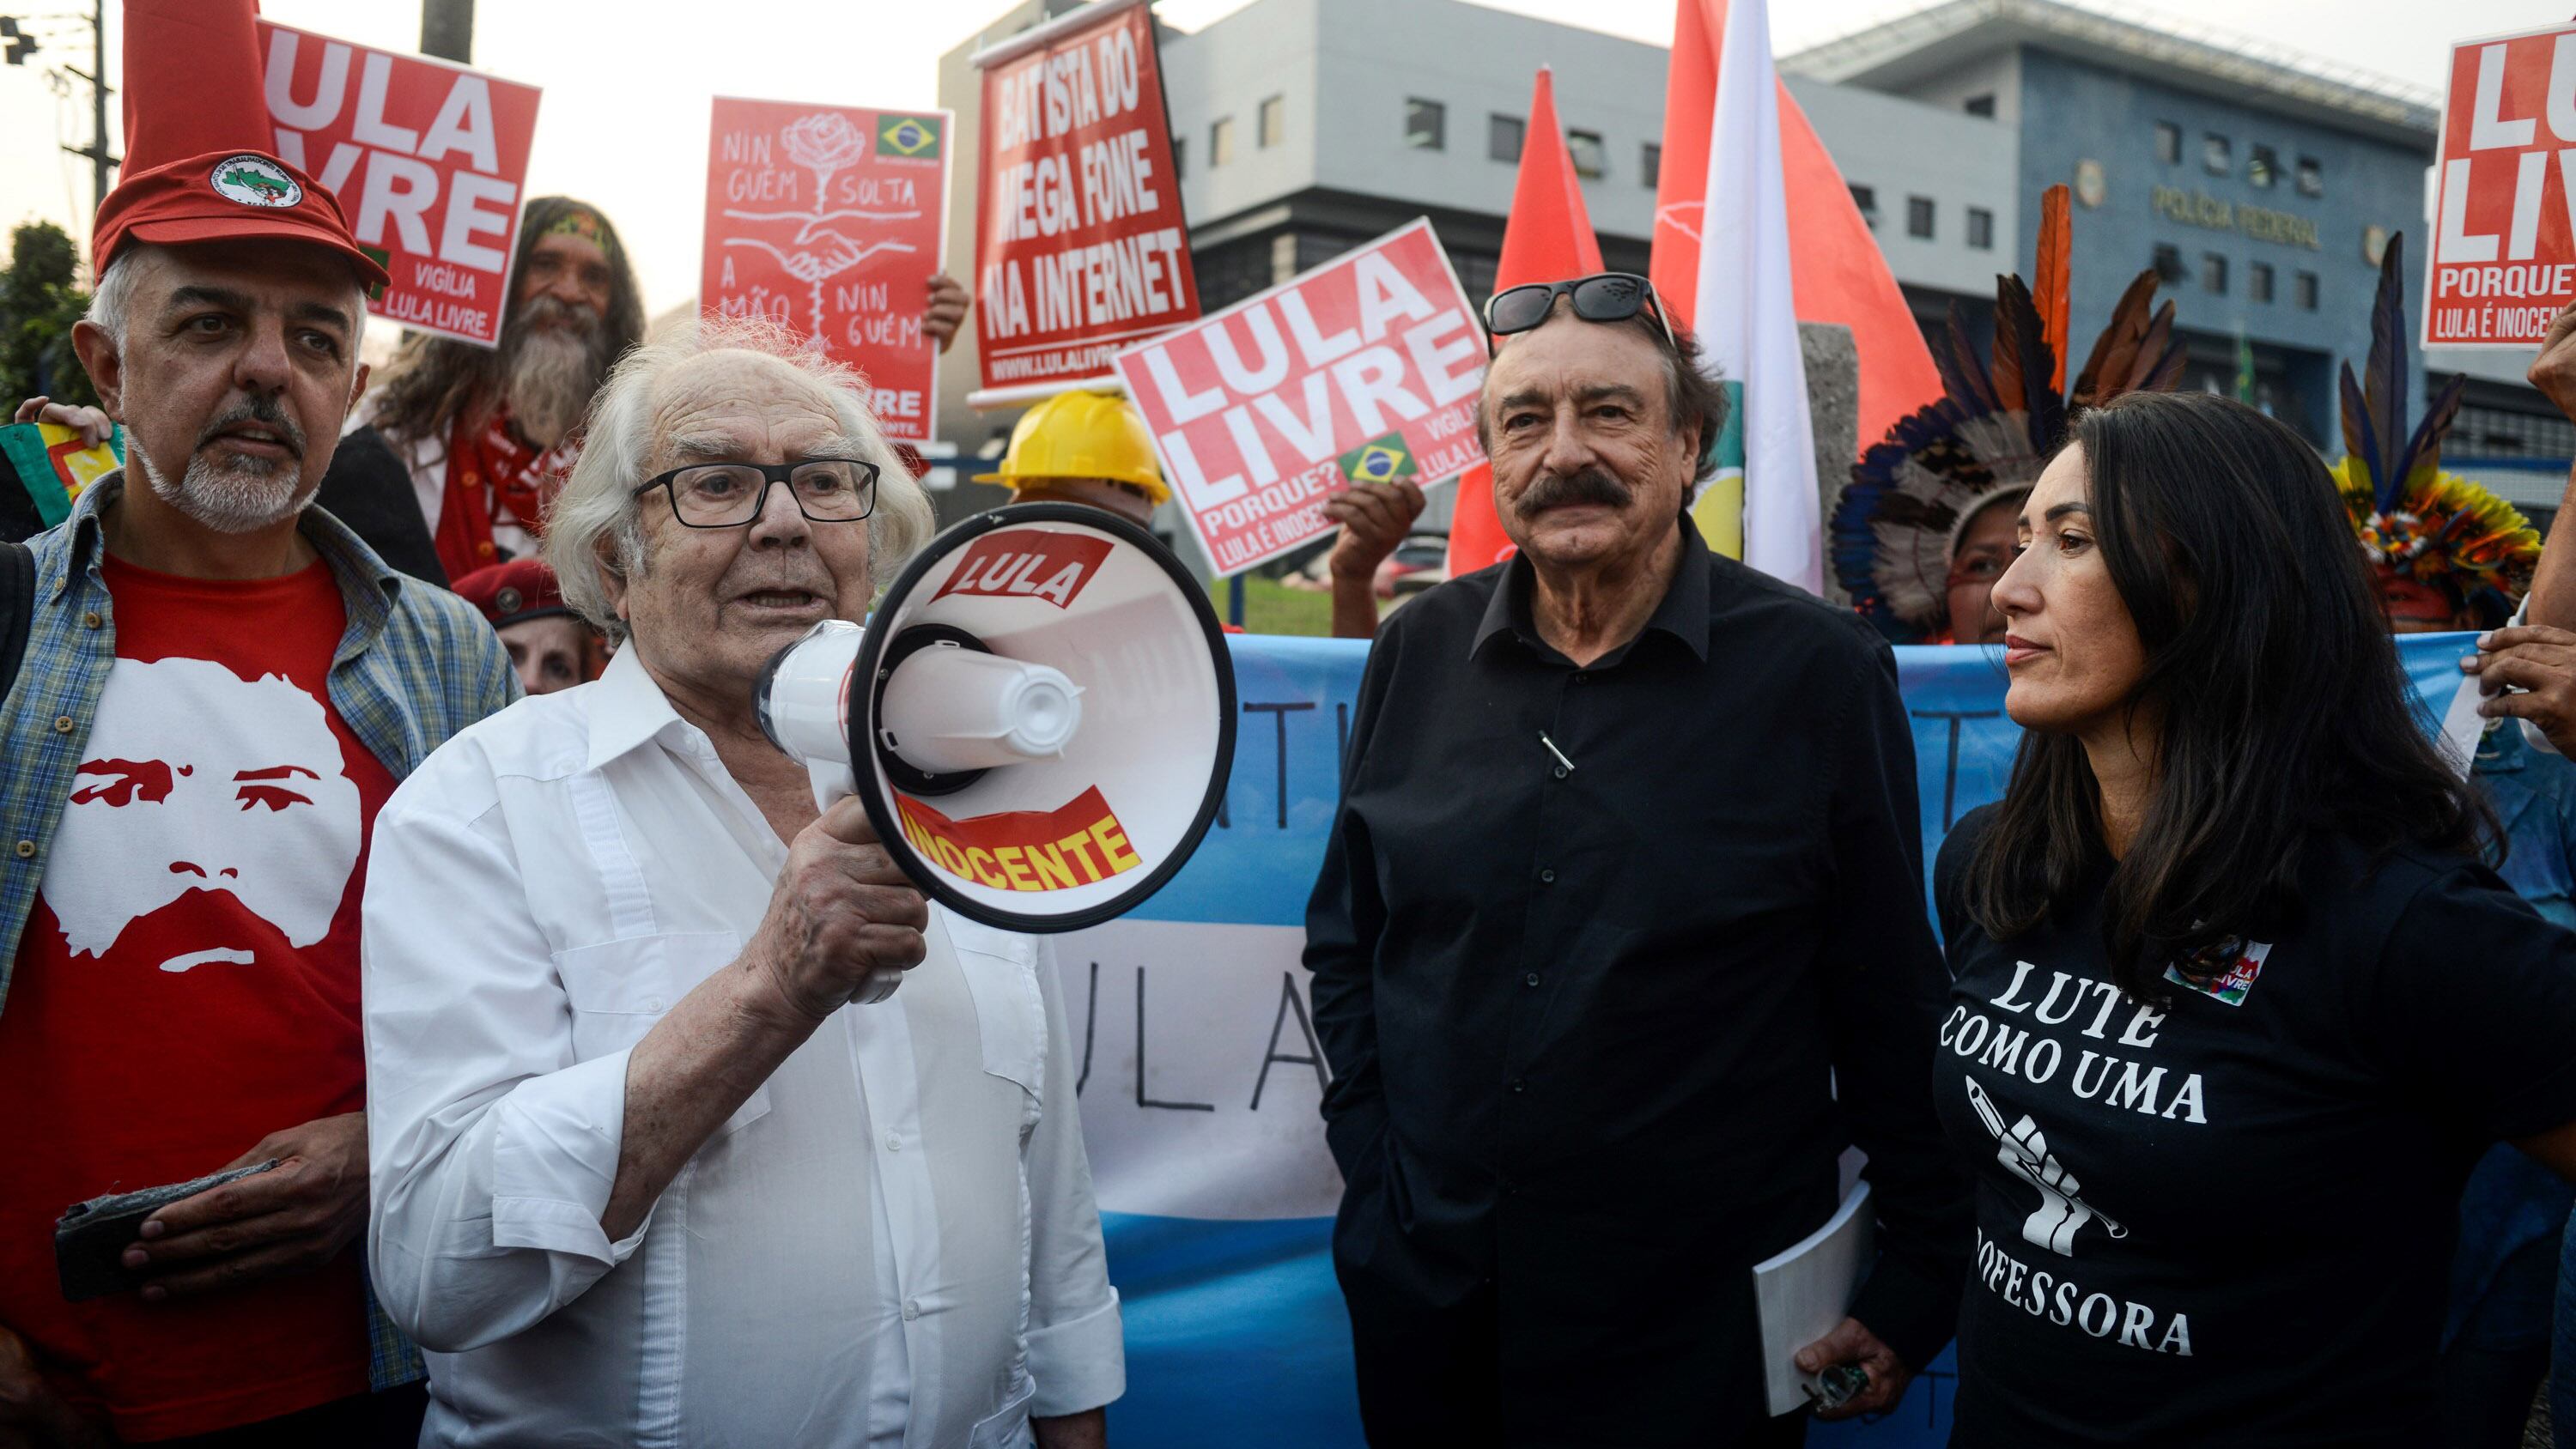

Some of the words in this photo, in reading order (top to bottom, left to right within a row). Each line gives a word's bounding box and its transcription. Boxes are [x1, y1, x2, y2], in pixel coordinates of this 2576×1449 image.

[999, 44, 1099, 153] BATISTA
[1099, 27, 1139, 118] DO
[722, 133, 771, 163] NIN
[727, 165, 798, 203] GUÉM
[839, 175, 917, 208] SOLTA
[997, 153, 1079, 245] MEGA
[1079, 129, 1159, 227] FONE
[415, 262, 477, 300] VIGÍLIA
[720, 256, 737, 288] A
[836, 282, 888, 313] NIN
[985, 260, 1030, 340] NA
[1035, 227, 1186, 333] INTERNET
[385, 290, 434, 324] LULA
[435, 302, 490, 338] LIVRE.
[848, 312, 922, 352] GUÉM
[1142, 251, 1437, 425] LULA
[2436, 307, 2477, 338] LULA
[2481, 301, 2494, 337] É
[1160, 307, 1484, 512] LIVRE
[1419, 443, 1469, 479] LULA
[1203, 462, 1338, 537] PORQUE?
[1217, 531, 1263, 567] LULA
[1258, 522, 1276, 549] É
[949, 551, 1085, 605] LULA
[897, 800, 1142, 892] INOCENTE
[1989, 960, 2172, 1049] LUTE
[1940, 1004, 2063, 1084] COMO
[2071, 1049, 2208, 1125] UMA
